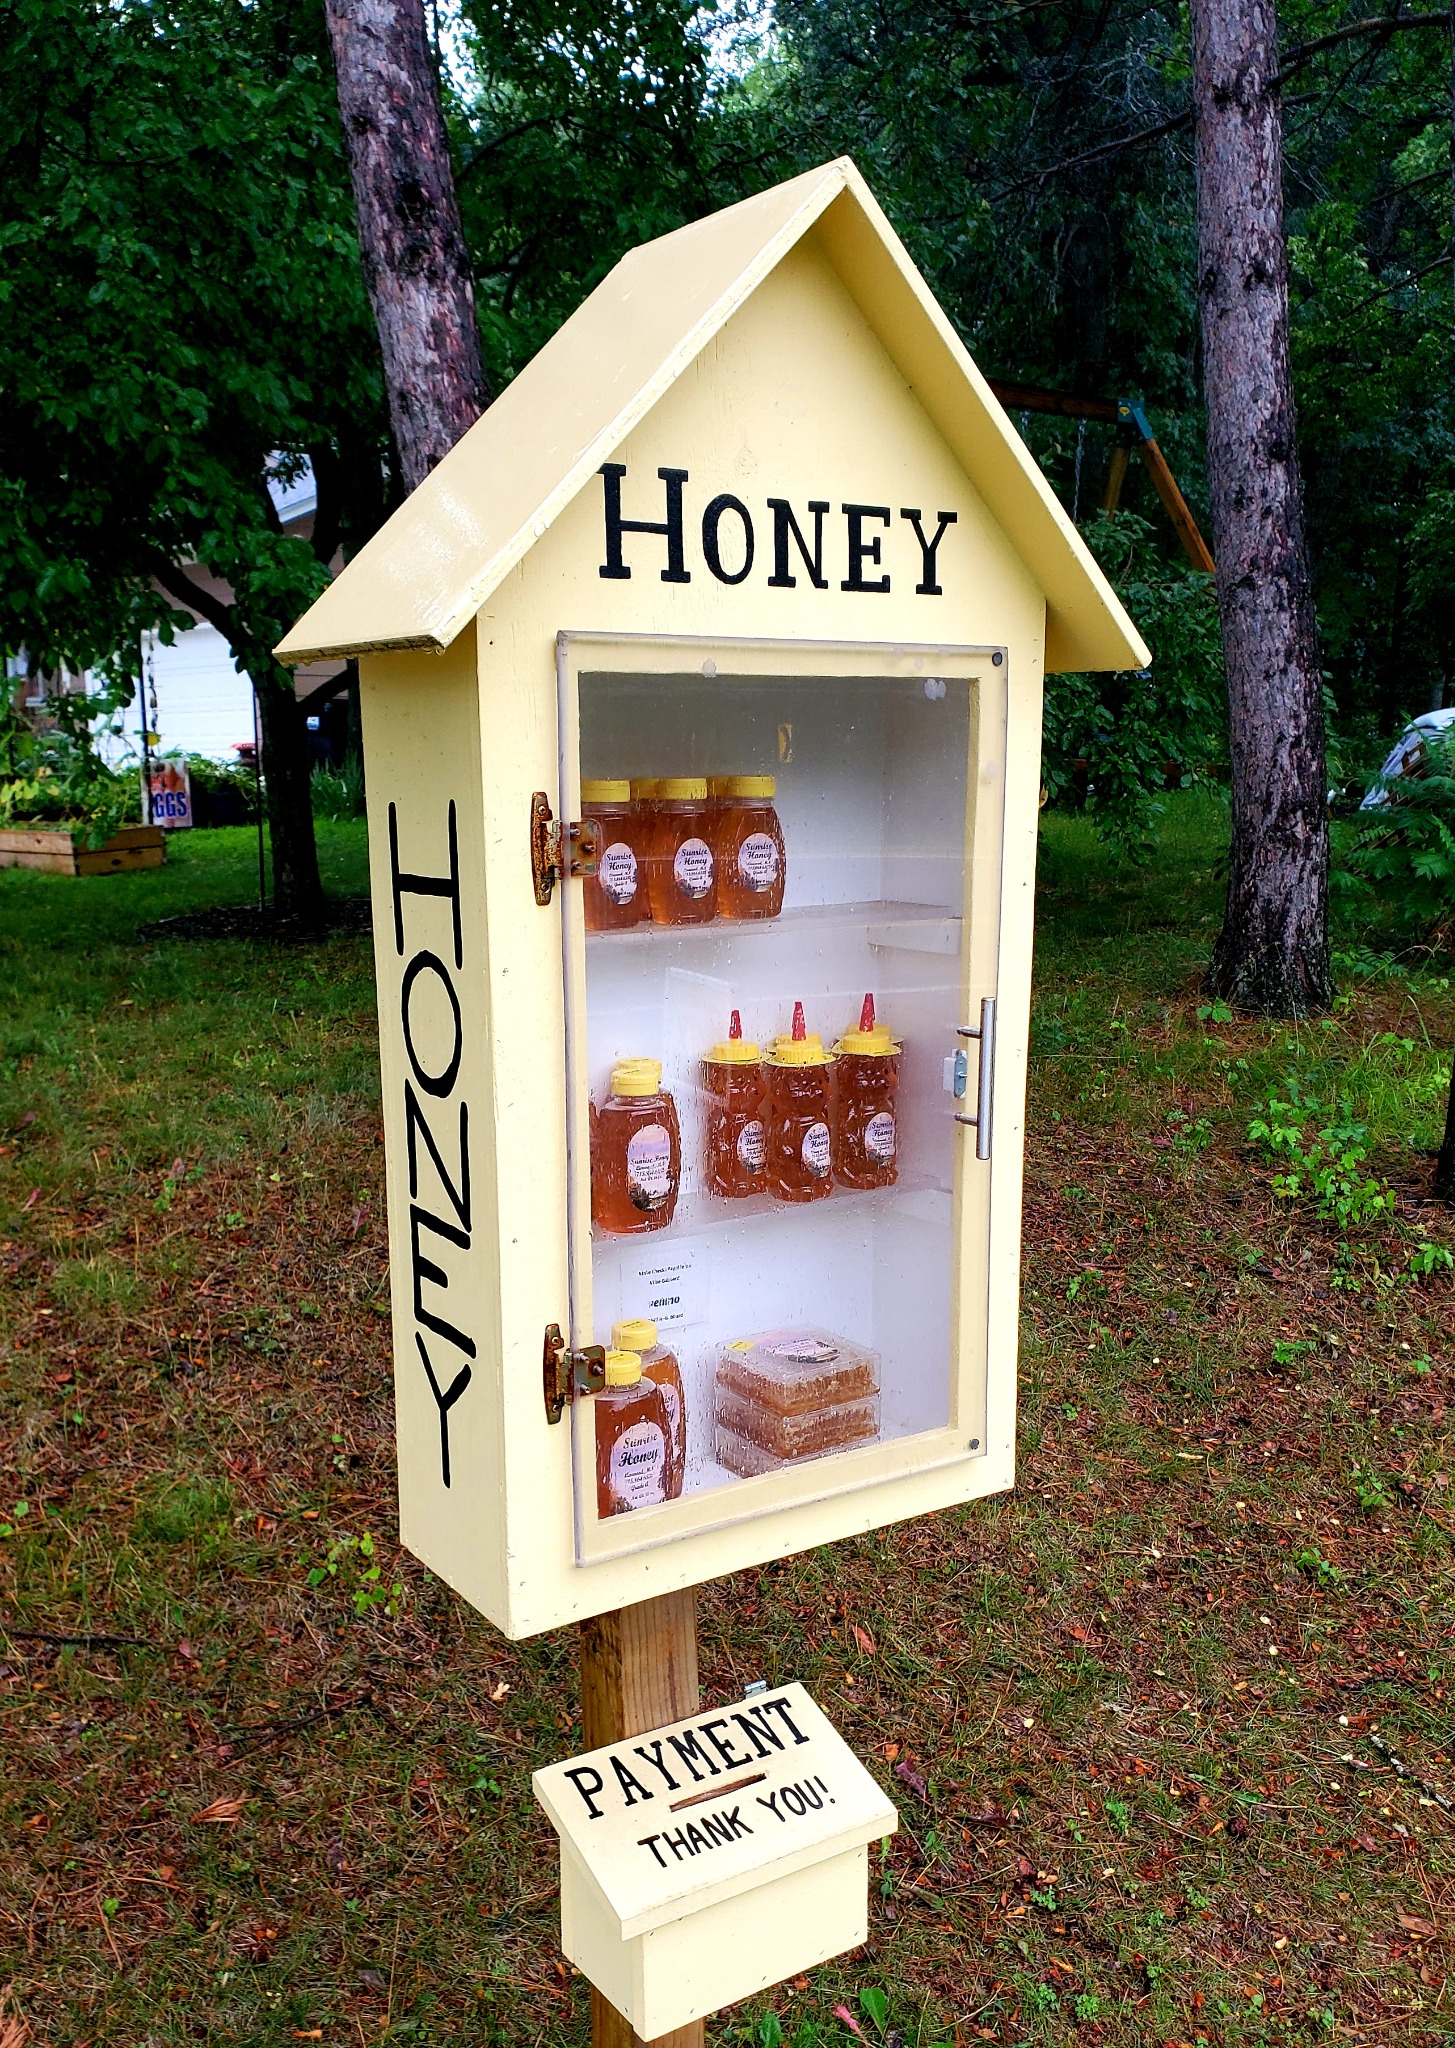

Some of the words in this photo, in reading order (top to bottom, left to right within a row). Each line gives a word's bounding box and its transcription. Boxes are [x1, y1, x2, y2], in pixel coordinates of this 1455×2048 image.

[596, 462, 958, 596] HONEY
[152, 791, 187, 818] GGS
[681, 848, 708, 857] Sunrise
[746, 843, 773, 851] Sunrise
[606, 853, 632, 861] Sunrise
[683, 857, 708, 866] Honey
[747, 851, 773, 860] Honey
[608, 862, 632, 871] Honey
[387, 798, 477, 1489] HONEY
[623, 1434, 658, 1450] Sunrise
[618, 1448, 659, 1468] Honey
[564, 1697, 811, 1819] PAYMENT
[637, 1806, 754, 1868] THANK
[756, 1775, 836, 1823] YOU!
